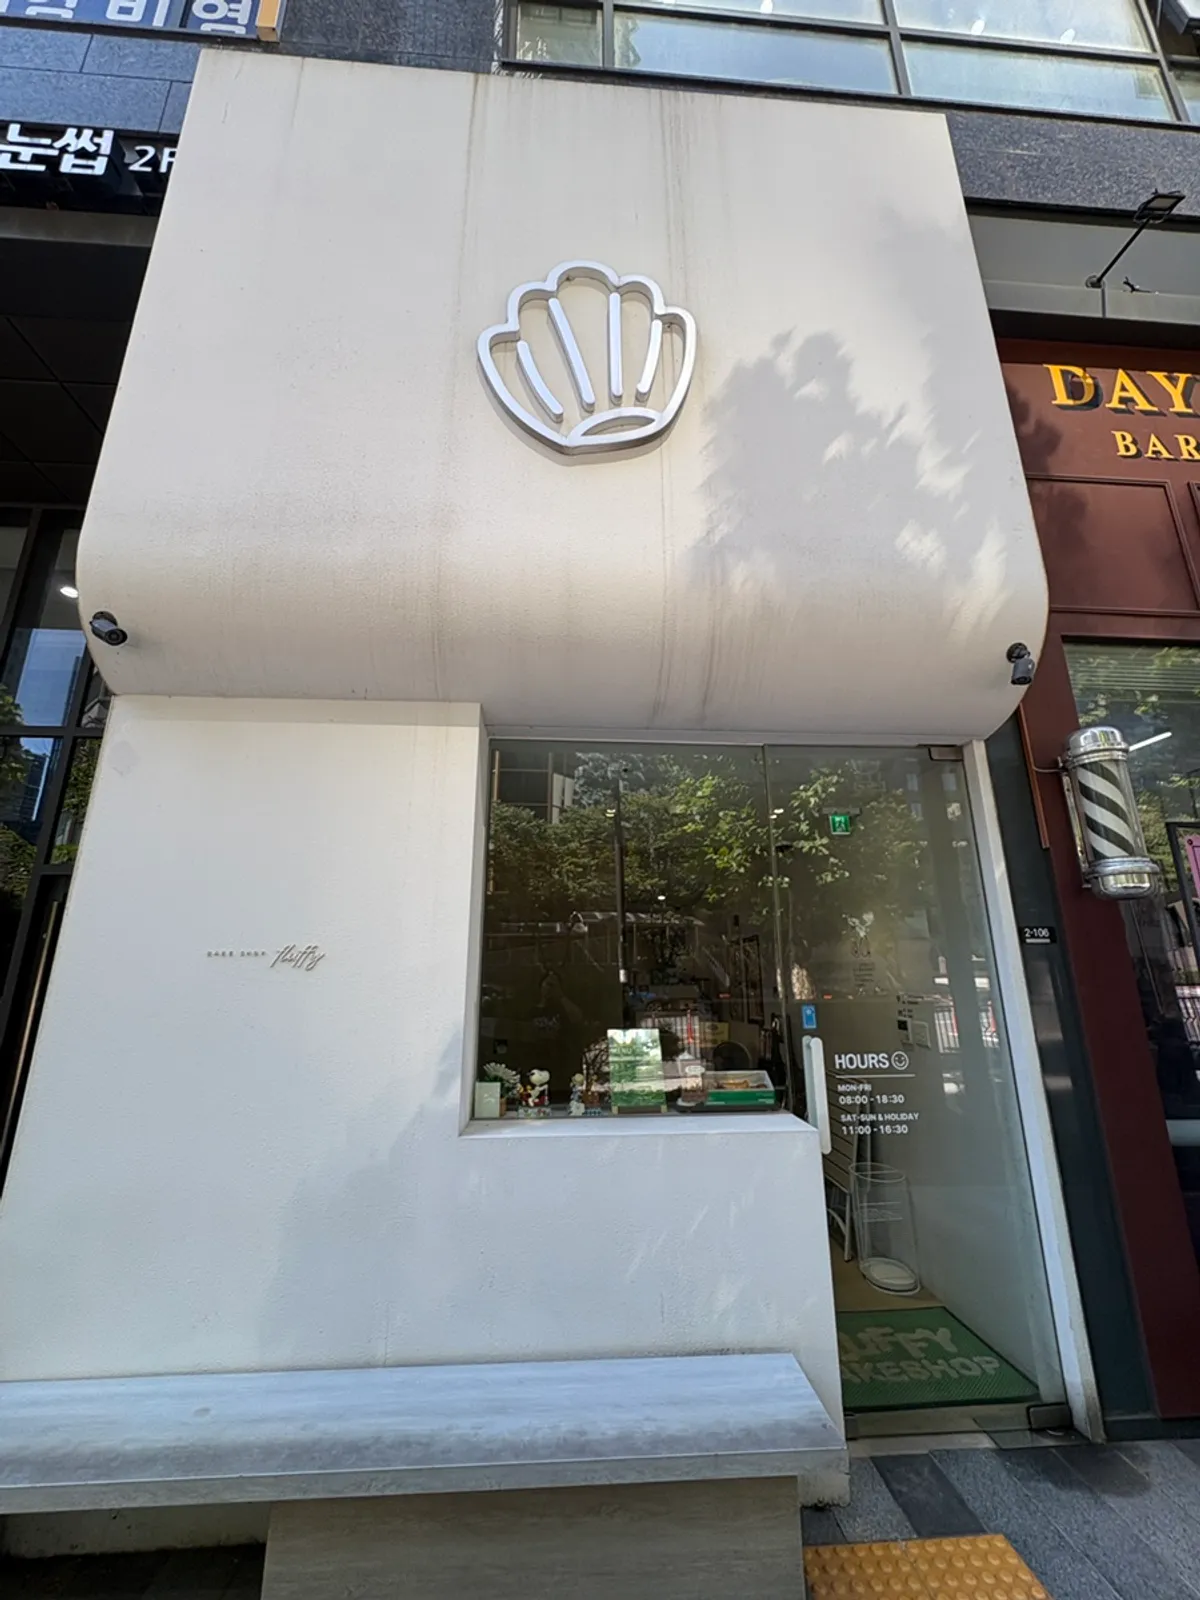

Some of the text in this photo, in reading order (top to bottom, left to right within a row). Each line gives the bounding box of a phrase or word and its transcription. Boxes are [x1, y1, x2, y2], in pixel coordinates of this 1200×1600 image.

[0, 124, 114, 175] 눈썹
[834, 1053, 890, 1070] HOURS
[884, 1112, 919, 1121] HOLIDAY
[842, 1126, 872, 1135] 11:00
